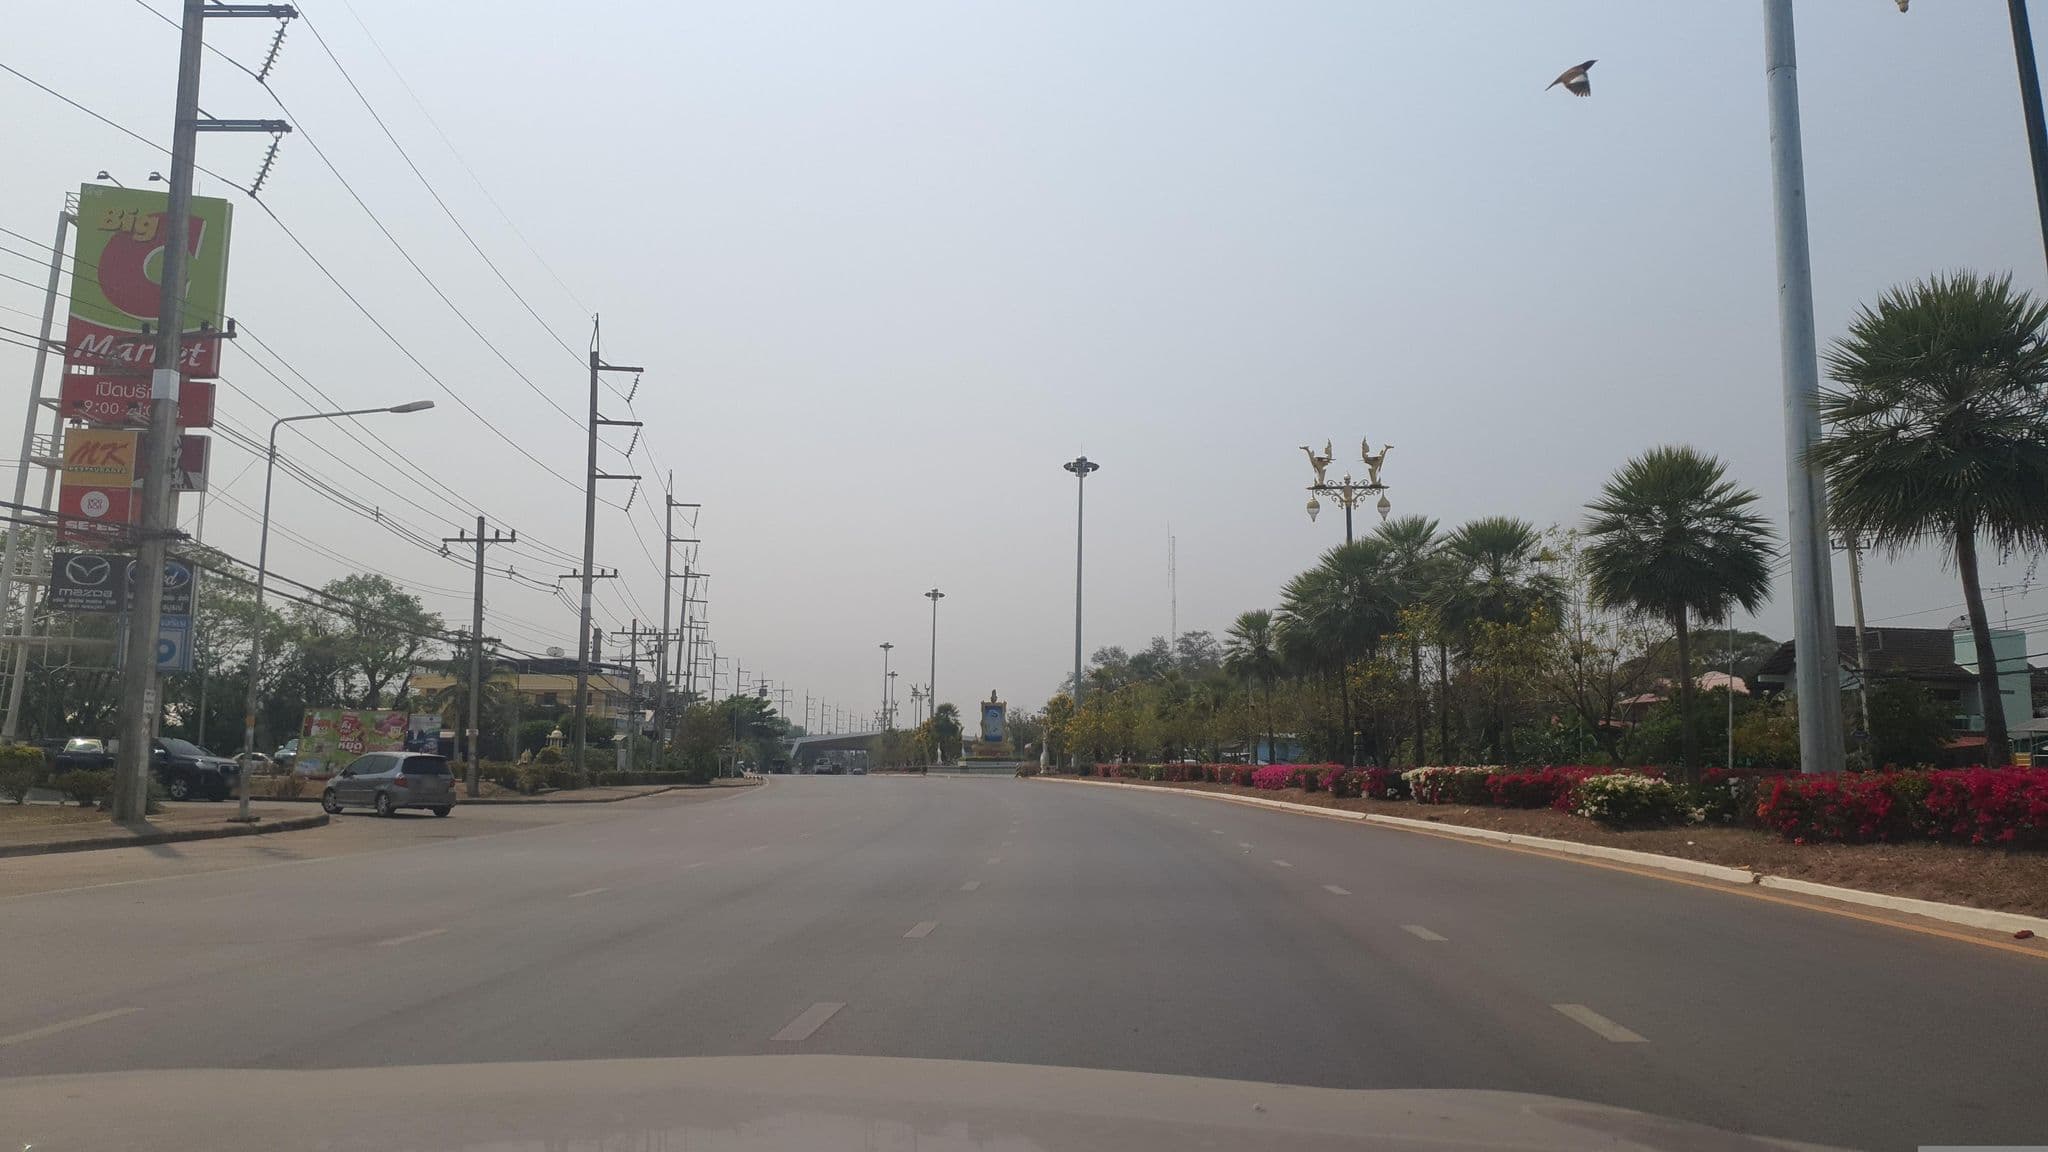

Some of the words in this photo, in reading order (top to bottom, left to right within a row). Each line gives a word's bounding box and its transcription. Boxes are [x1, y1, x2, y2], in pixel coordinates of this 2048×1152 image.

[99, 208, 159, 242] Big
[69, 440, 129, 464] MK
[58, 588, 113, 598] mazda
